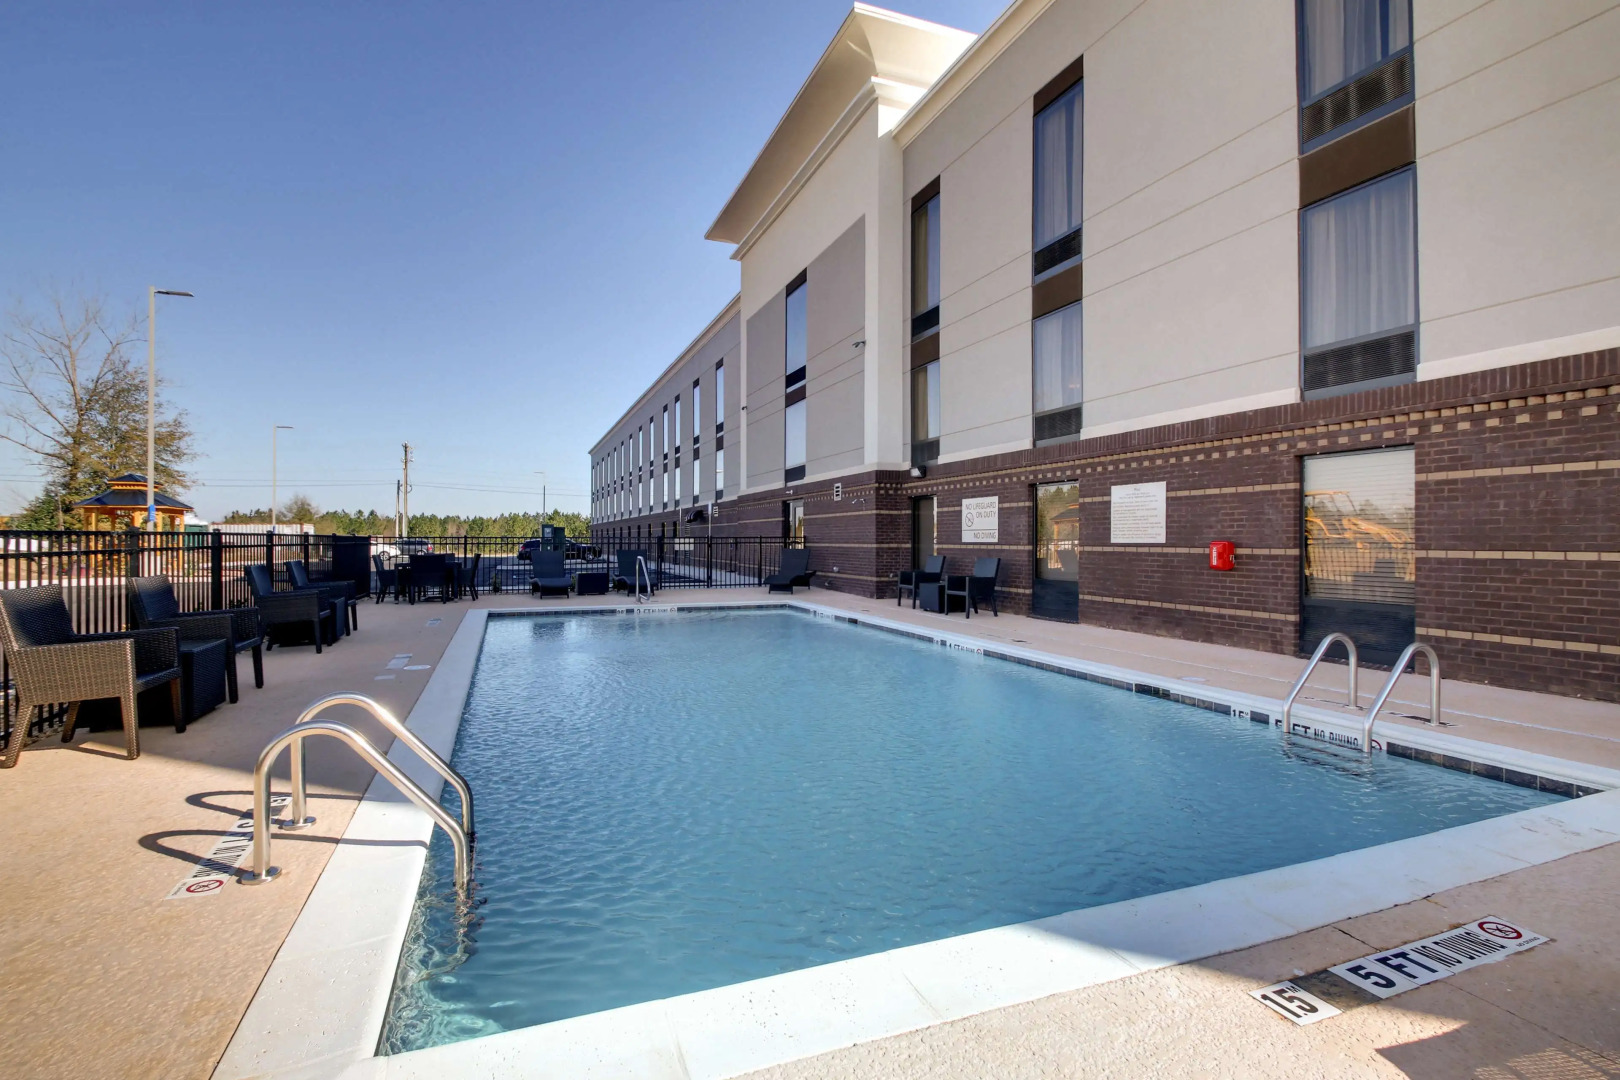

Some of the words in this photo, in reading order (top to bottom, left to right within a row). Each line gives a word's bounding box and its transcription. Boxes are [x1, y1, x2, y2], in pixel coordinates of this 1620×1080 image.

[973, 501, 996, 510] LIFEGUARD
[984, 510, 997, 518] DUTY
[981, 531, 997, 539] DIVING
[1409, 945, 1463, 968] NO
[1431, 931, 1508, 961] DIVING
[1345, 964, 1397, 989] 5
[1374, 951, 1439, 980] FT
